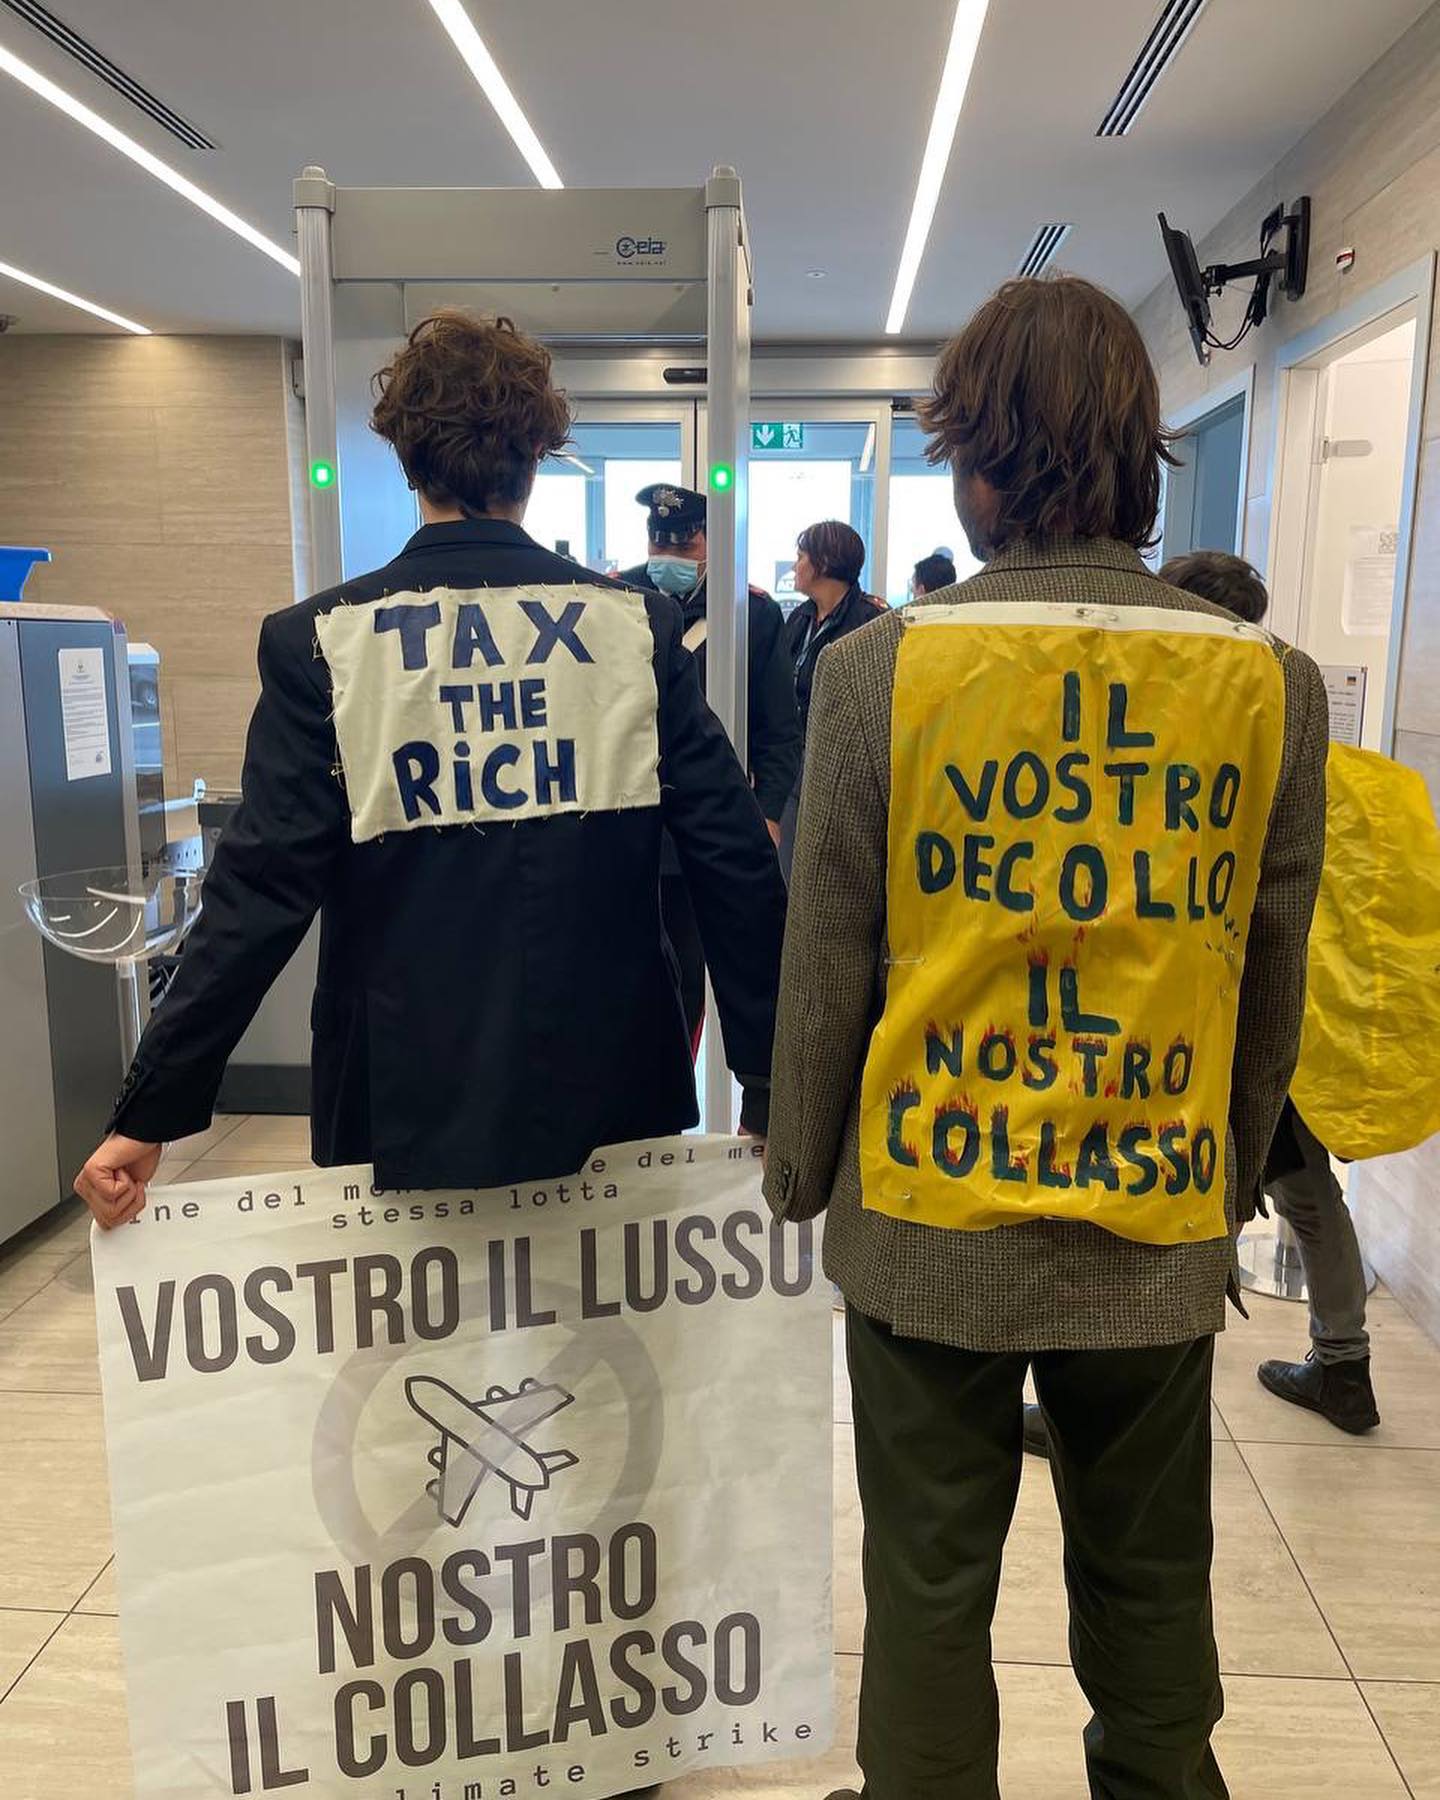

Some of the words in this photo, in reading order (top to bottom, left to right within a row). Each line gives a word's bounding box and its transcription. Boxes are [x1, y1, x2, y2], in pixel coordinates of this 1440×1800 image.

[374, 601, 595, 670] TAX
[439, 679, 547, 733] THE
[1062, 671, 1155, 747] IL
[945, 751, 1241, 831] VOSTRO
[1028, 962, 1121, 1035] IL
[925, 1027, 1194, 1099] NOSTRO
[886, 1088, 1217, 1196] COLLASSO
[129, 1202, 200, 1225] ne
[237, 1185, 305, 1212] del
[638, 1148, 695, 1168] del
[728, 1144, 765, 1160] me
[332, 1198, 474, 1229] stessa
[510, 1180, 617, 1210] lotta
[115, 1245, 460, 1382] VOSTRO
[488, 1235, 557, 1332] IL
[580, 1210, 814, 1319] LUSSO
[314, 1522, 657, 1675] NOSTRO
[226, 1695, 309, 1795] IL
[334, 1611, 761, 1779] COLLASSO
[396, 1764, 585, 1800] limate
[634, 1722, 812, 1767] strike
